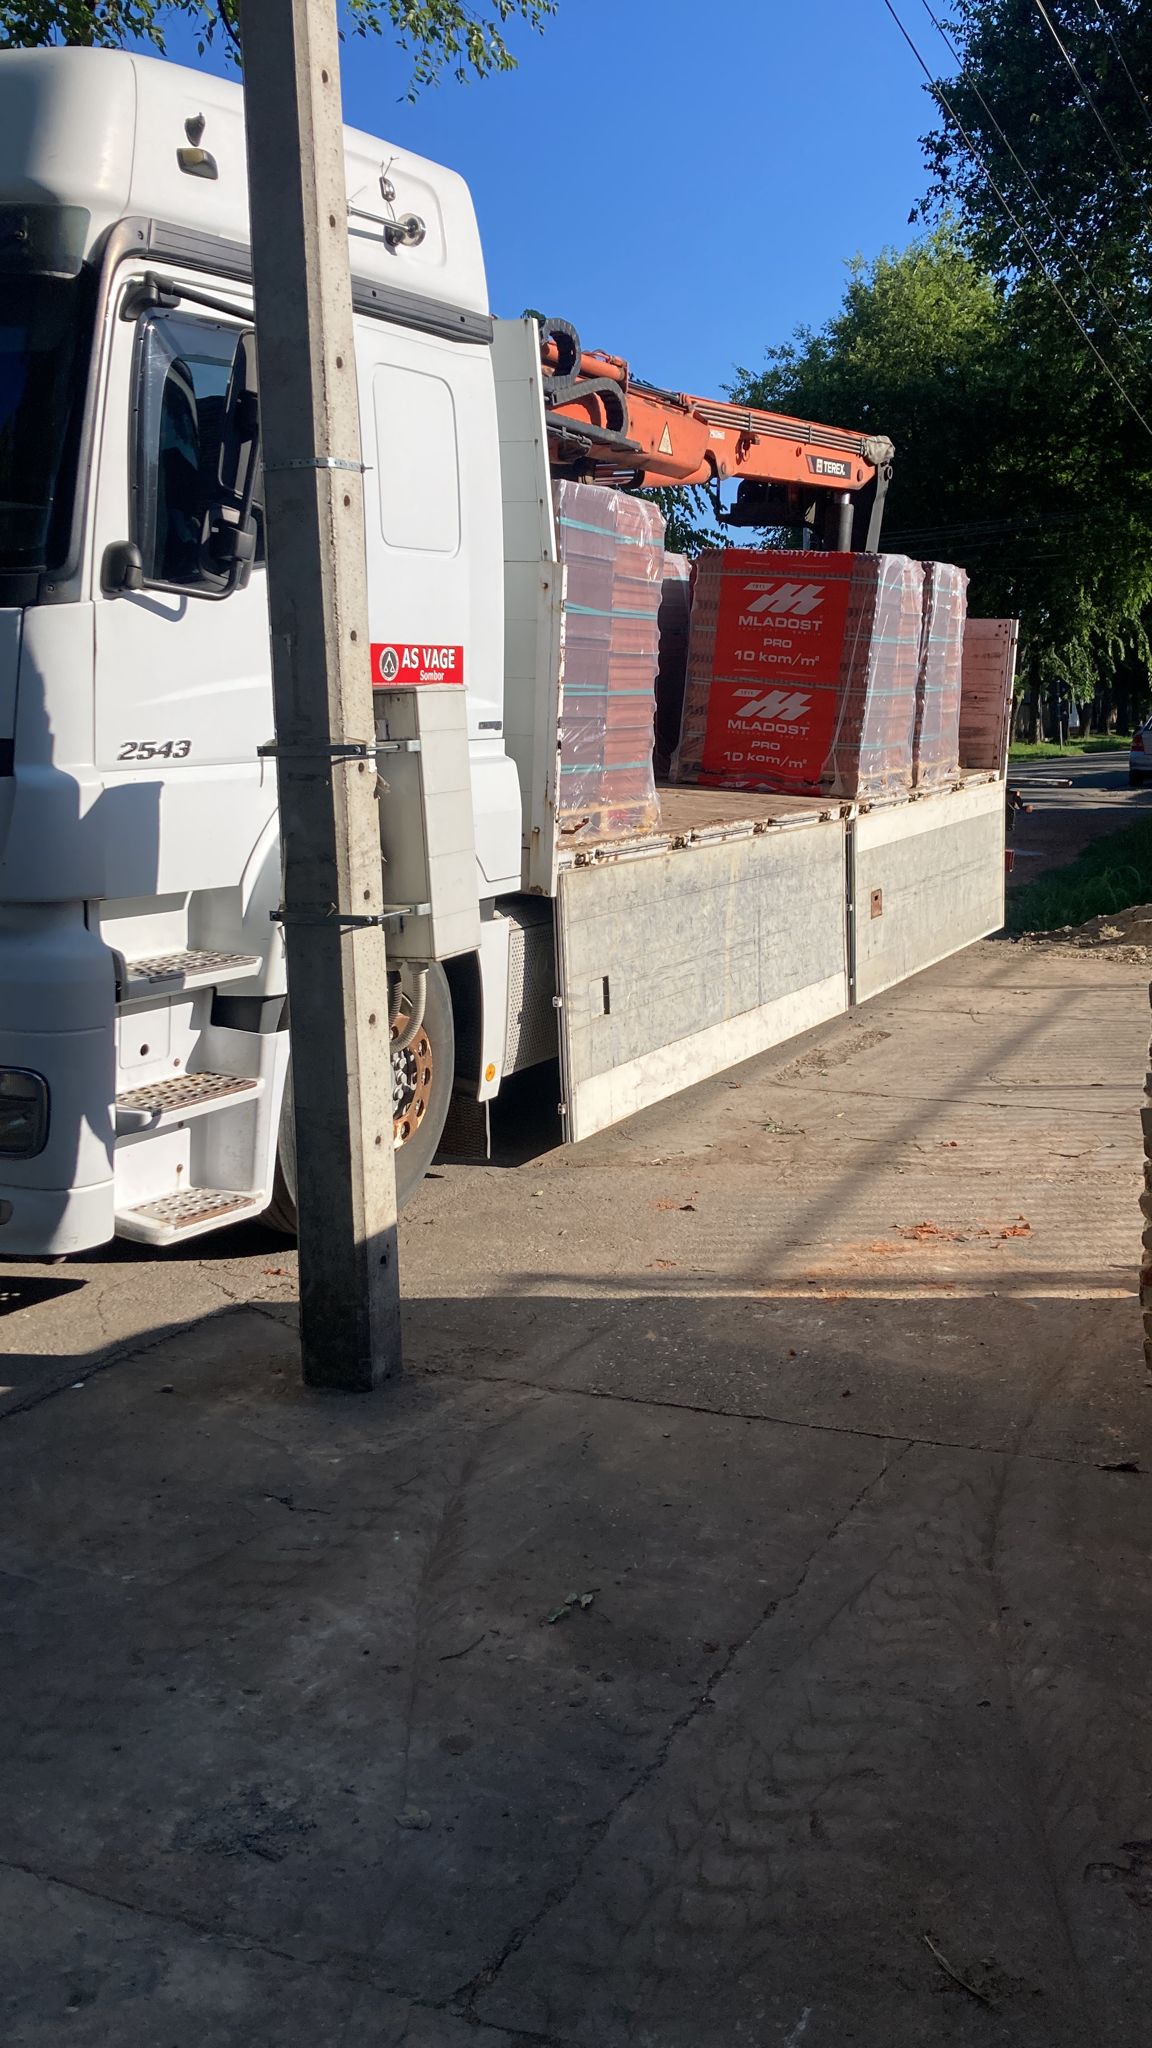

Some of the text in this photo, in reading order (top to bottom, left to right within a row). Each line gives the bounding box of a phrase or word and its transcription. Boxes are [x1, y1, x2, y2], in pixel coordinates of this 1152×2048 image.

[823, 460, 846, 476] TEREX
[738, 615, 823, 631] MLADOST
[763, 638, 792, 649] PRO
[401, 647, 456, 670] AS VAGE
[734, 650, 755, 661] 10
[419, 669, 445, 681] Sombor
[727, 719, 810, 736] MLADOST
[117, 740, 192, 761] 2543
[751, 740, 781, 751] PRO
[723, 751, 744, 762] 10
